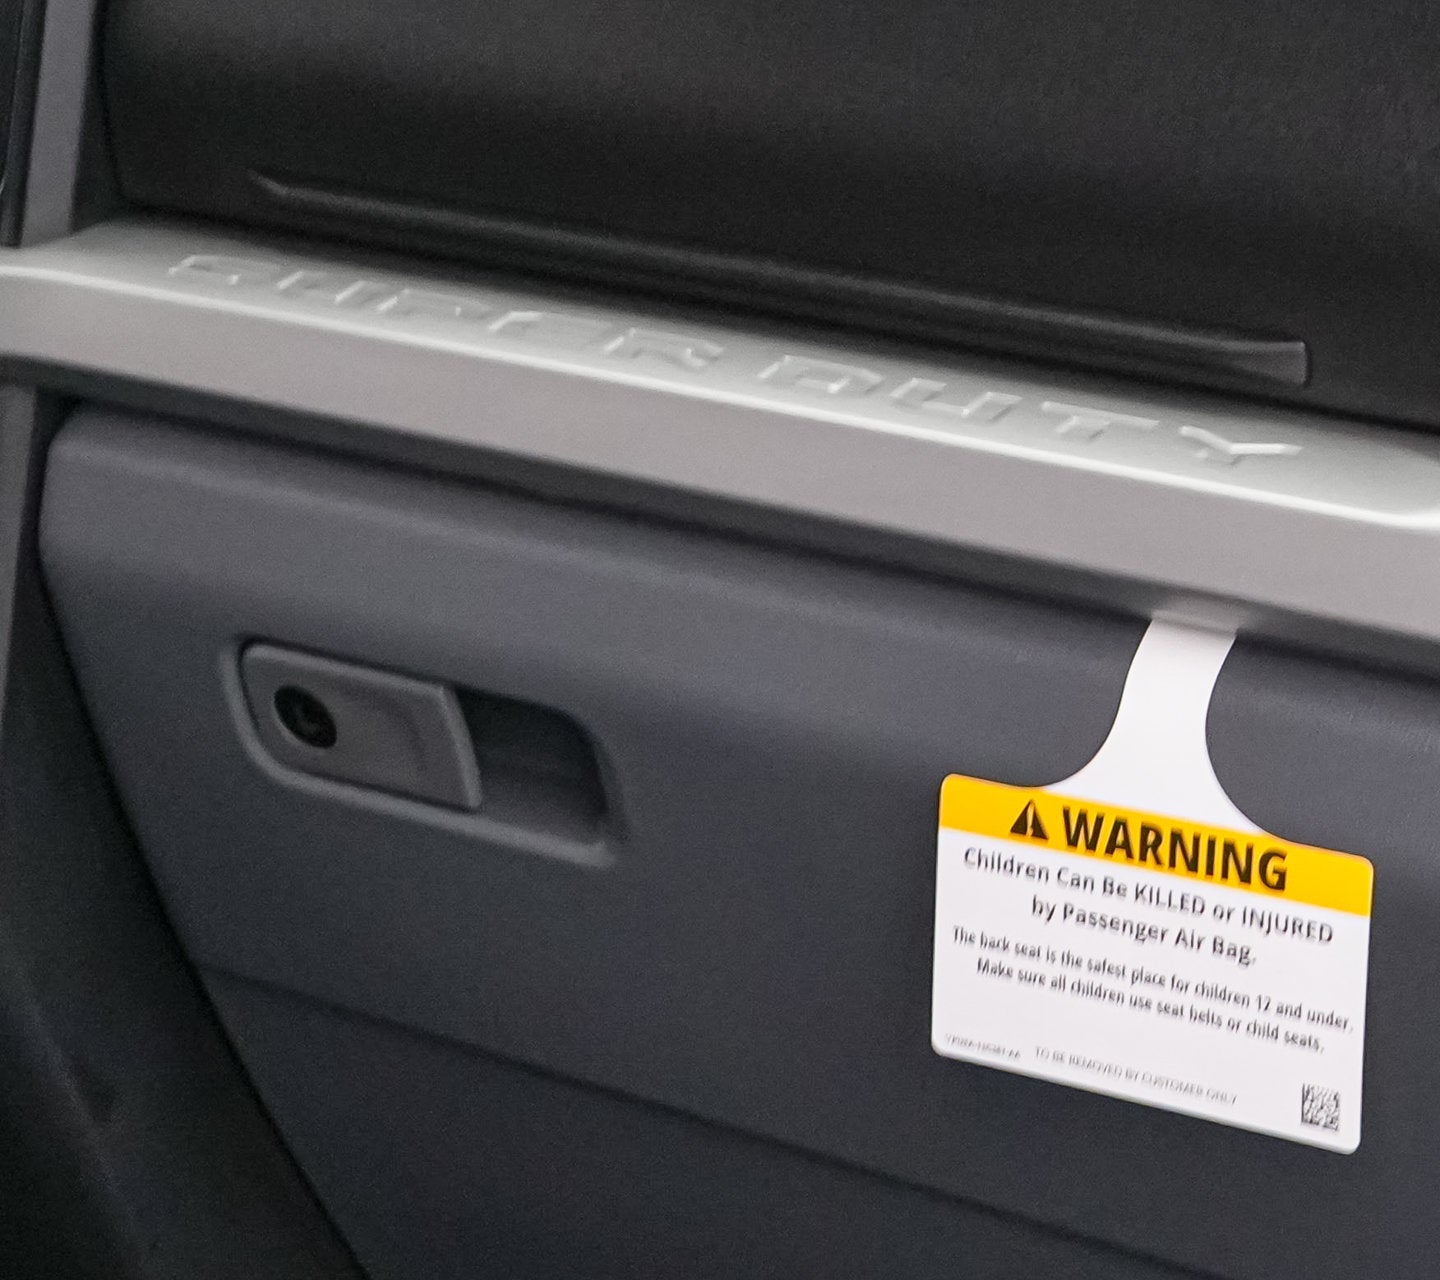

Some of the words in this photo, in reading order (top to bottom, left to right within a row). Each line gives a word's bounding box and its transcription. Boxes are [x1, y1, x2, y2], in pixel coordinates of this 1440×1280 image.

[755, 353, 1305, 468] DUTY
[1063, 805, 1288, 891] WARNING
[964, 846, 1050, 882] Children
[1057, 867, 1095, 893] Can
[1102, 875, 1127, 897] Be
[1135, 882, 1206, 916] KILLED
[1213, 903, 1235, 921] or
[1243, 906, 1333, 943] INJURED
[1032, 894, 1056, 922] by
[1063, 902, 1169, 943] Passenger
[1175, 927, 1206, 950] Air
[1213, 936, 1256, 967] Bag.
[953, 925, 976, 945] The
[980, 931, 1010, 951] back
[1015, 942, 1041, 959] seat
[1046, 945, 1056, 964] is
[1062, 950, 1083, 969] the
[1087, 957, 1127, 978] safest
[1131, 966, 1166, 987] place
[1171, 974, 1190, 994] for
[1195, 981, 1250, 1008] children
[1256, 993, 1272, 1012] 12
[1276, 1003, 1302, 1019] and
[977, 957, 1013, 979] Make
[1018, 970, 1046, 986] sure
[1051, 974, 1066, 992] all
[1071, 978, 1125, 1005] children
[1129, 995, 1152, 1011] use
[1157, 1001, 1184, 1018] seat
[1190, 1004, 1222, 1027] belts
[1227, 1017, 1241, 1032] or
[1246, 1020, 1279, 1041] child
